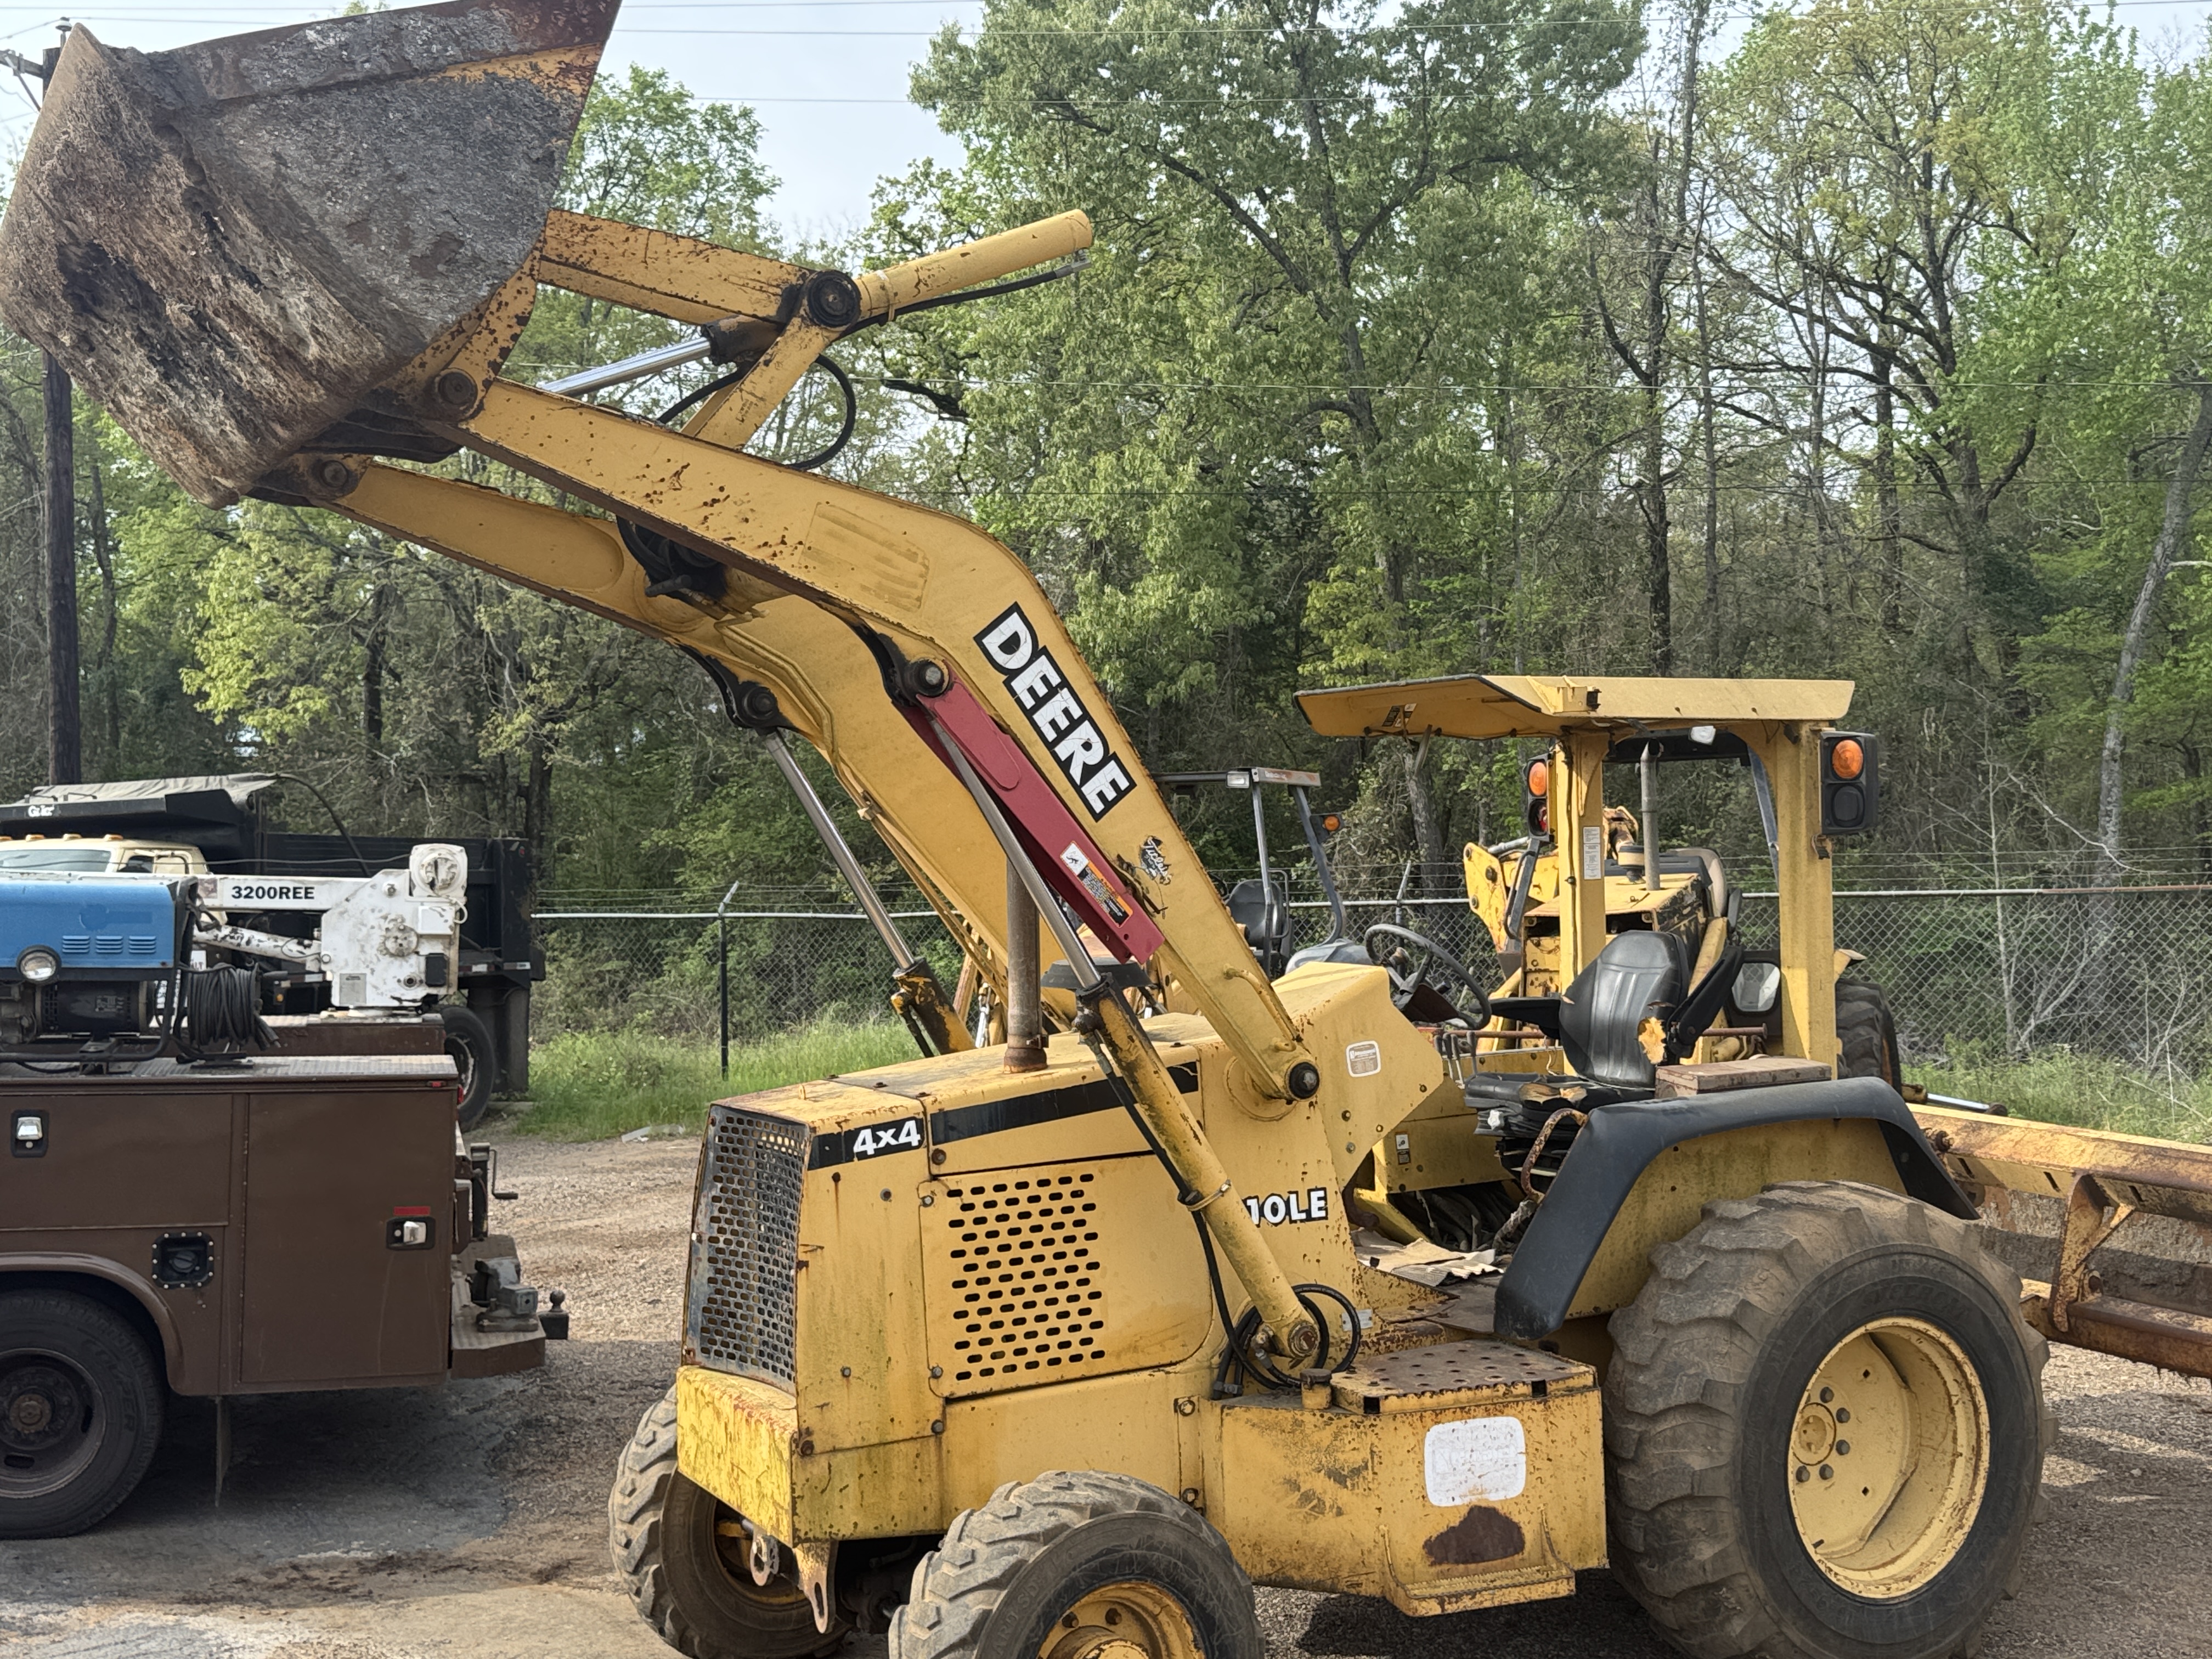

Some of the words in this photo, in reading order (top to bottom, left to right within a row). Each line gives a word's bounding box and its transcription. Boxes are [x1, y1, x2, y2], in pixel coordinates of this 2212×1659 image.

[981, 611, 1130, 815] DEERE
[231, 885, 315, 900] 3200REE
[853, 1120, 921, 1155] 4x4
[1246, 1190, 1326, 1225] 10LE
